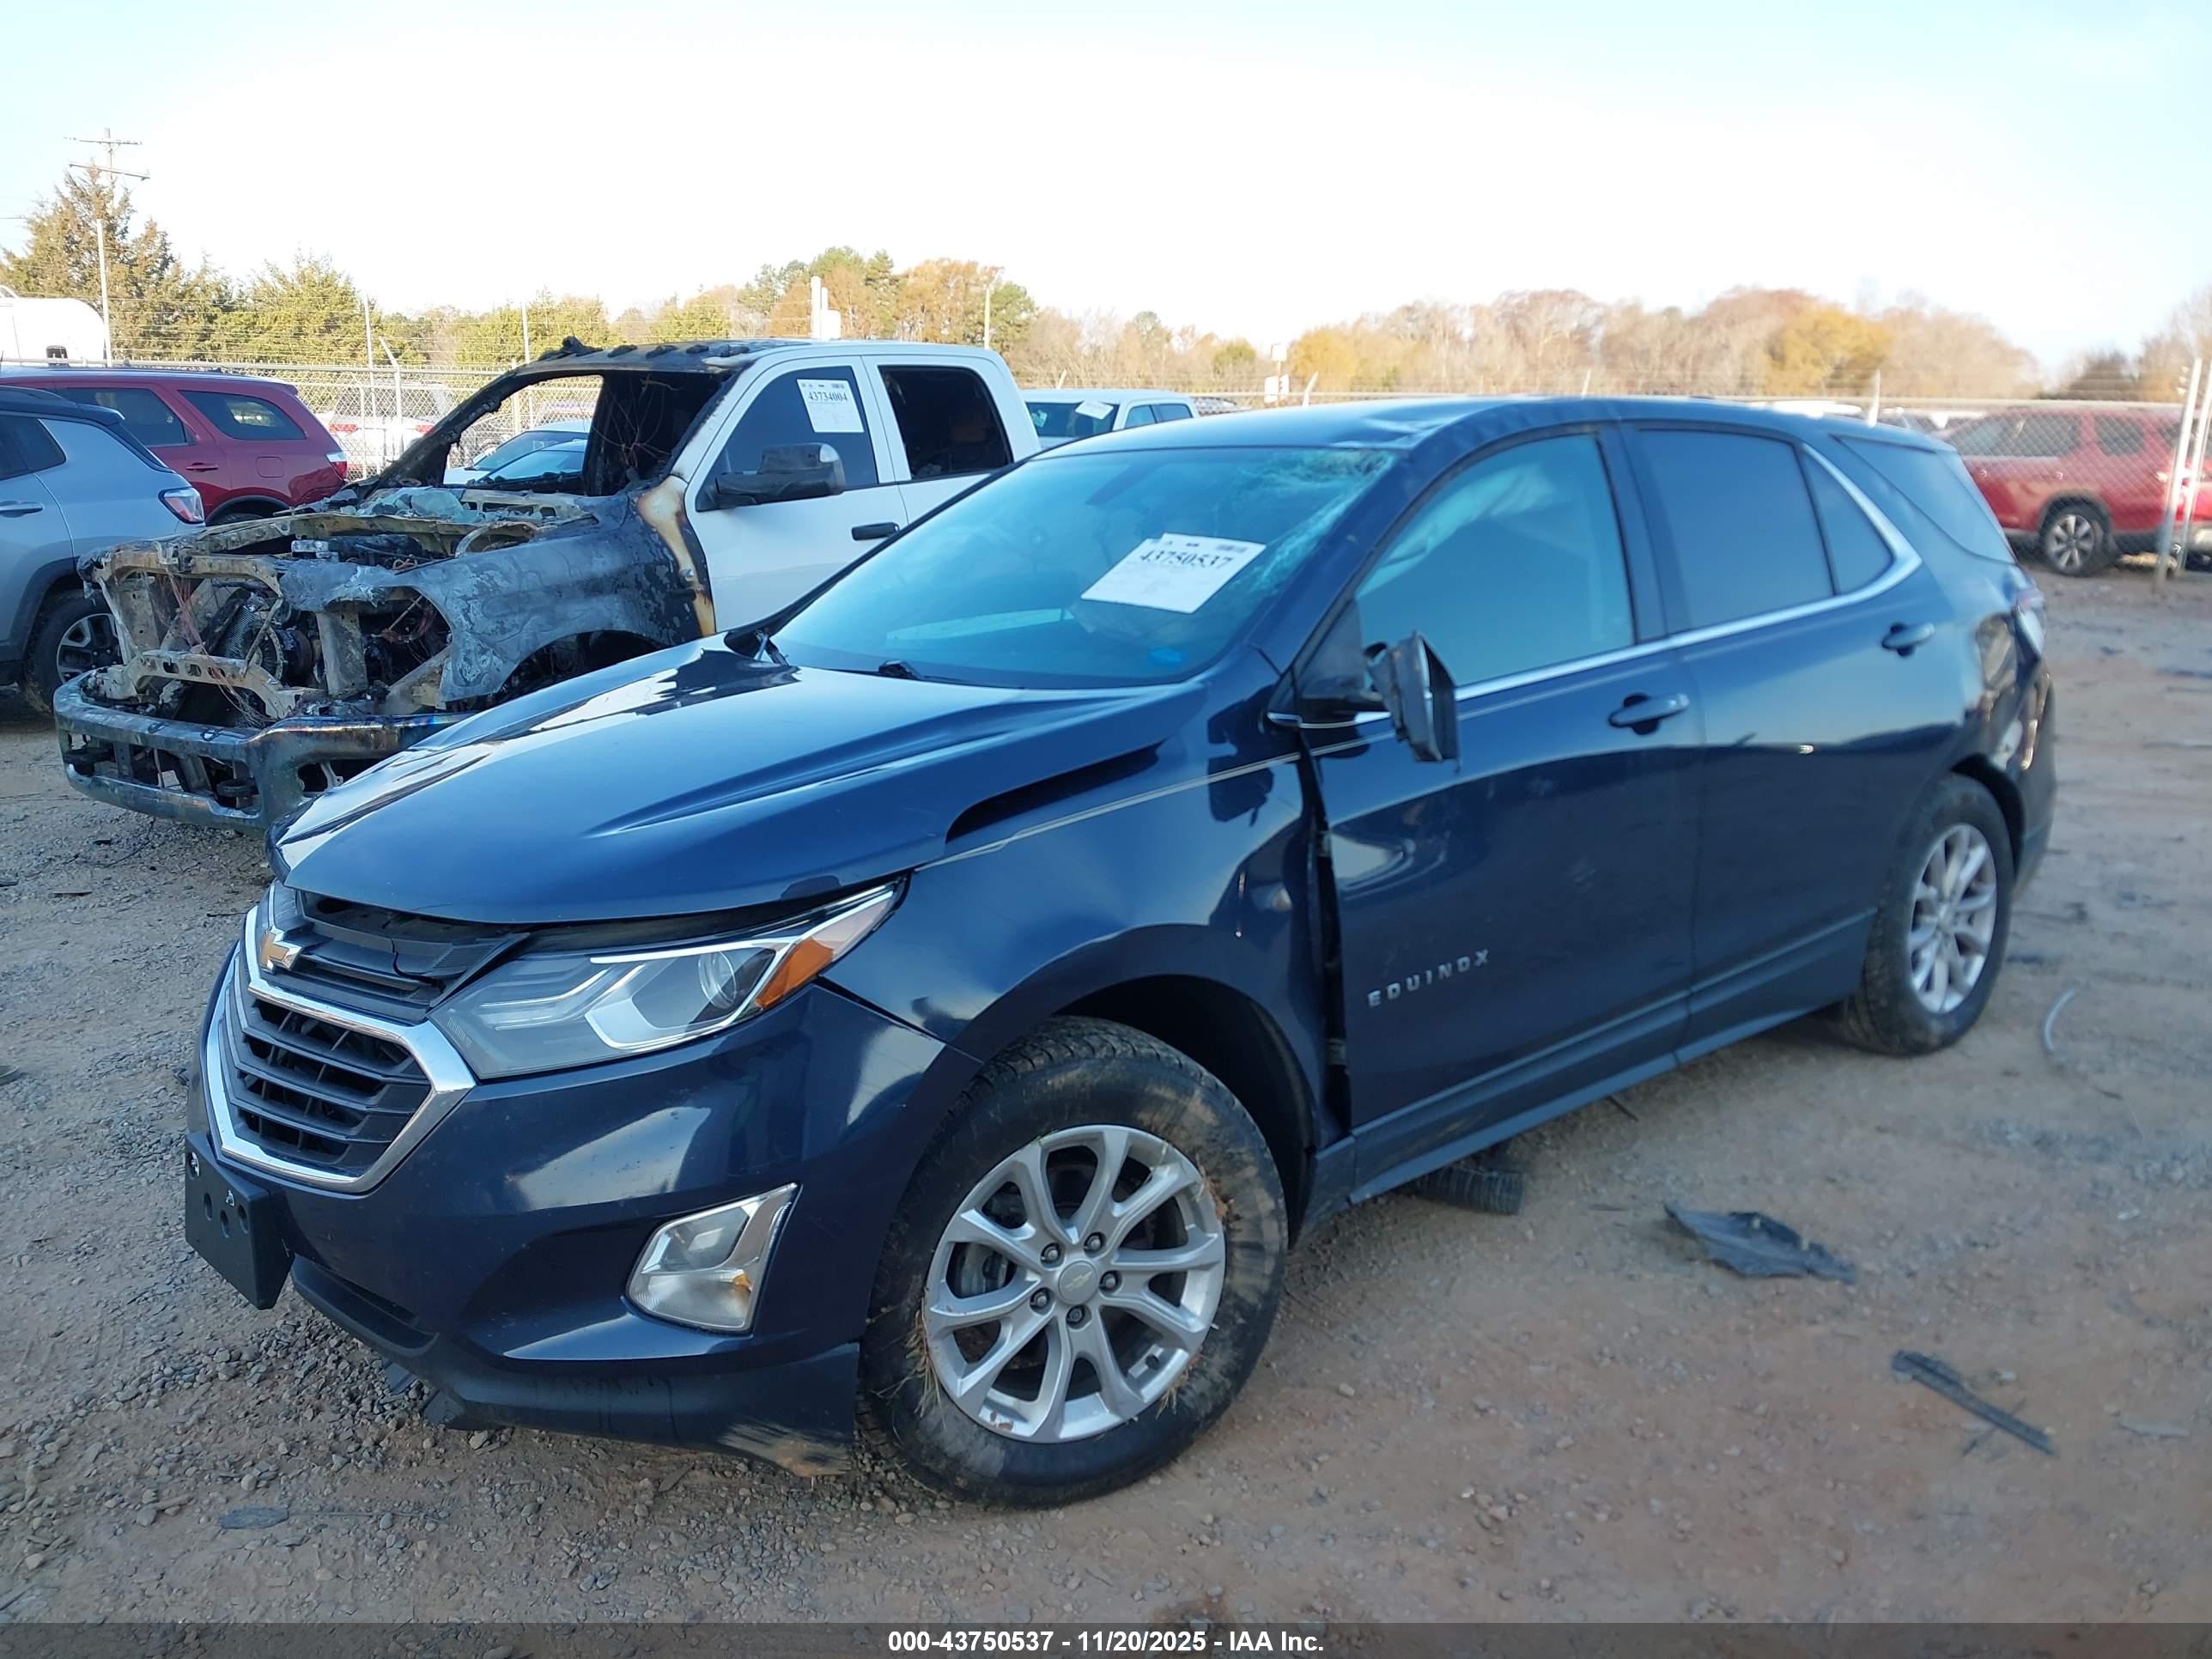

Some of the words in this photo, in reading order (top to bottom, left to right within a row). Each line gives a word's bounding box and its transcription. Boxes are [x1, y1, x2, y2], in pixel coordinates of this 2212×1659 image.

[808, 391, 848, 402] 43734004
[1139, 549, 1234, 569] 43750537
[1367, 949, 1489, 1008] EQUINOX
